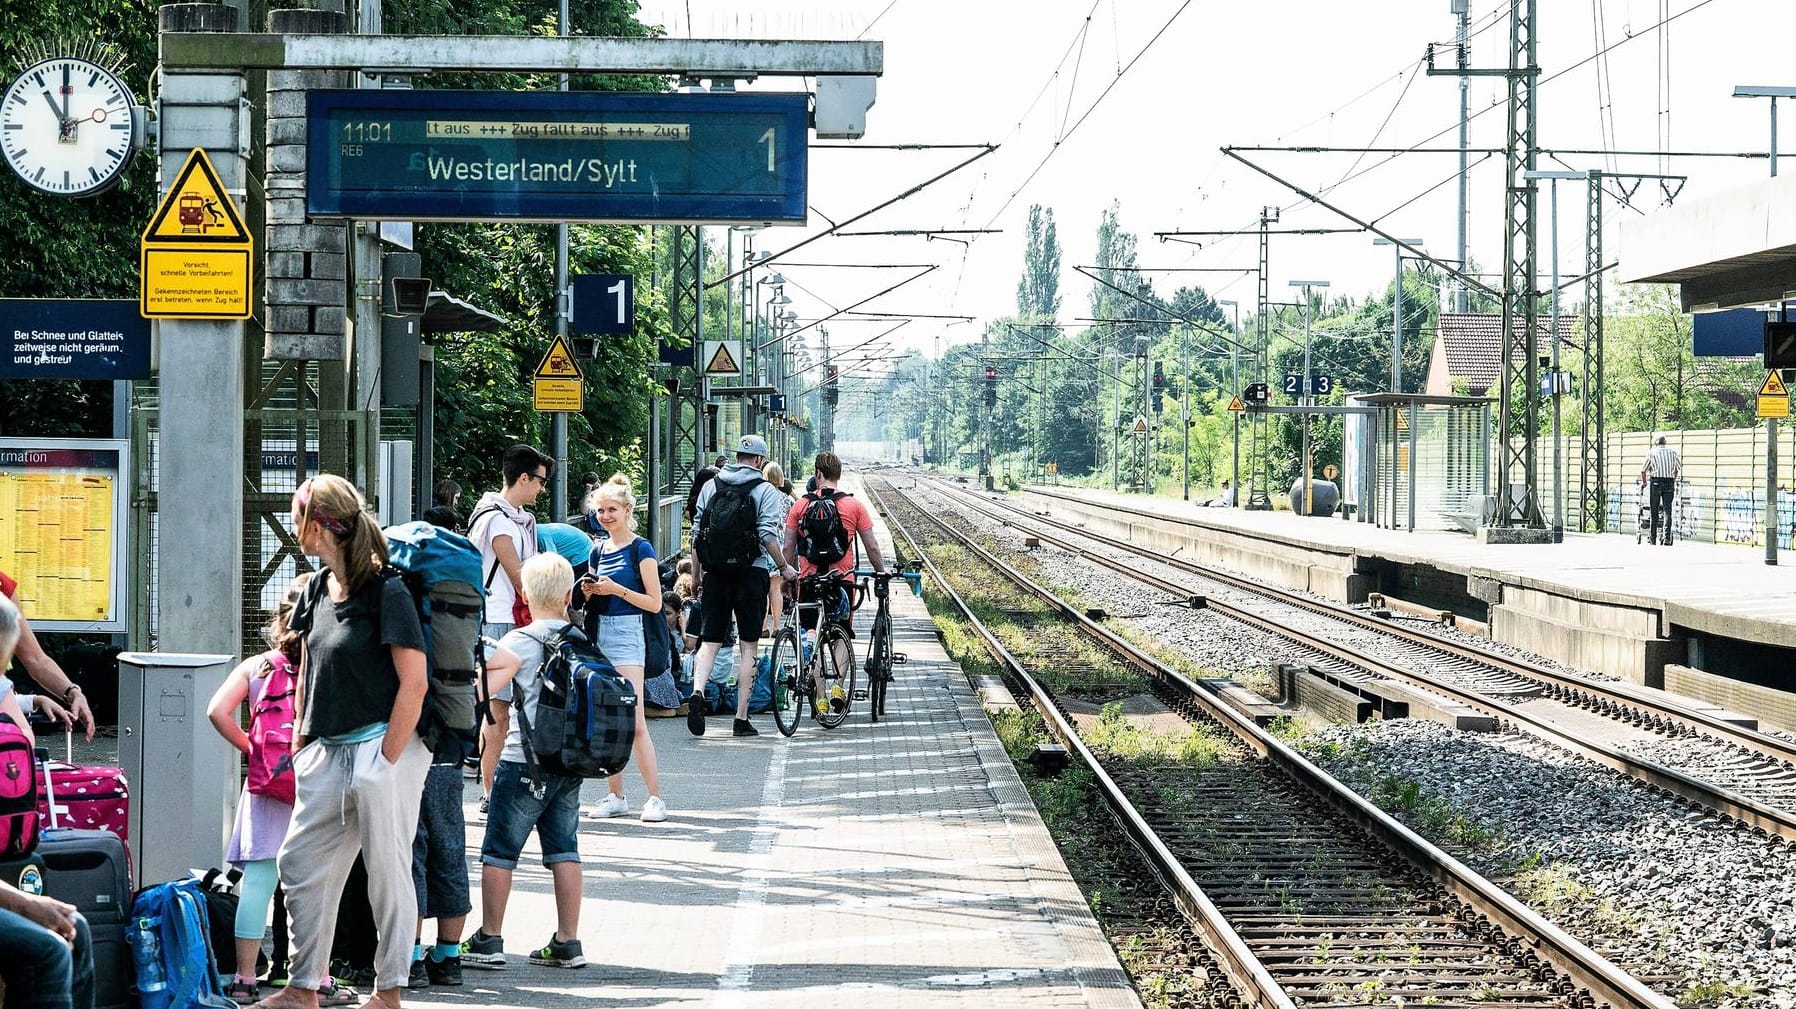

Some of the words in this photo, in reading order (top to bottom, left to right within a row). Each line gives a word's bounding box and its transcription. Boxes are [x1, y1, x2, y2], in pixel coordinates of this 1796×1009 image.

[343, 122, 391, 142] 11:01
[445, 125, 470, 135] aus
[512, 123, 539, 138] Zug
[581, 125, 608, 136] aus
[653, 124, 680, 138] Zug
[341, 144, 363, 157] RE6
[758, 128, 775, 171] 1
[427, 156, 637, 188] Westerland/Sylt
[215, 297, 227, 305] Zug
[608, 280, 625, 323] 1
[14, 330, 29, 340] Bei
[31, 330, 66, 340] Schnee
[68, 330, 86, 340] und
[88, 330, 124, 340] Glatteis
[14, 342, 57, 352] zeitweise
[59, 343, 82, 352] nicht
[14, 354, 32, 364] und
[34, 354, 73, 366] gestreut
[1286, 376, 1297, 392] 2
[1318, 376, 1329, 393] 3
[779, 395, 785, 409] 1
